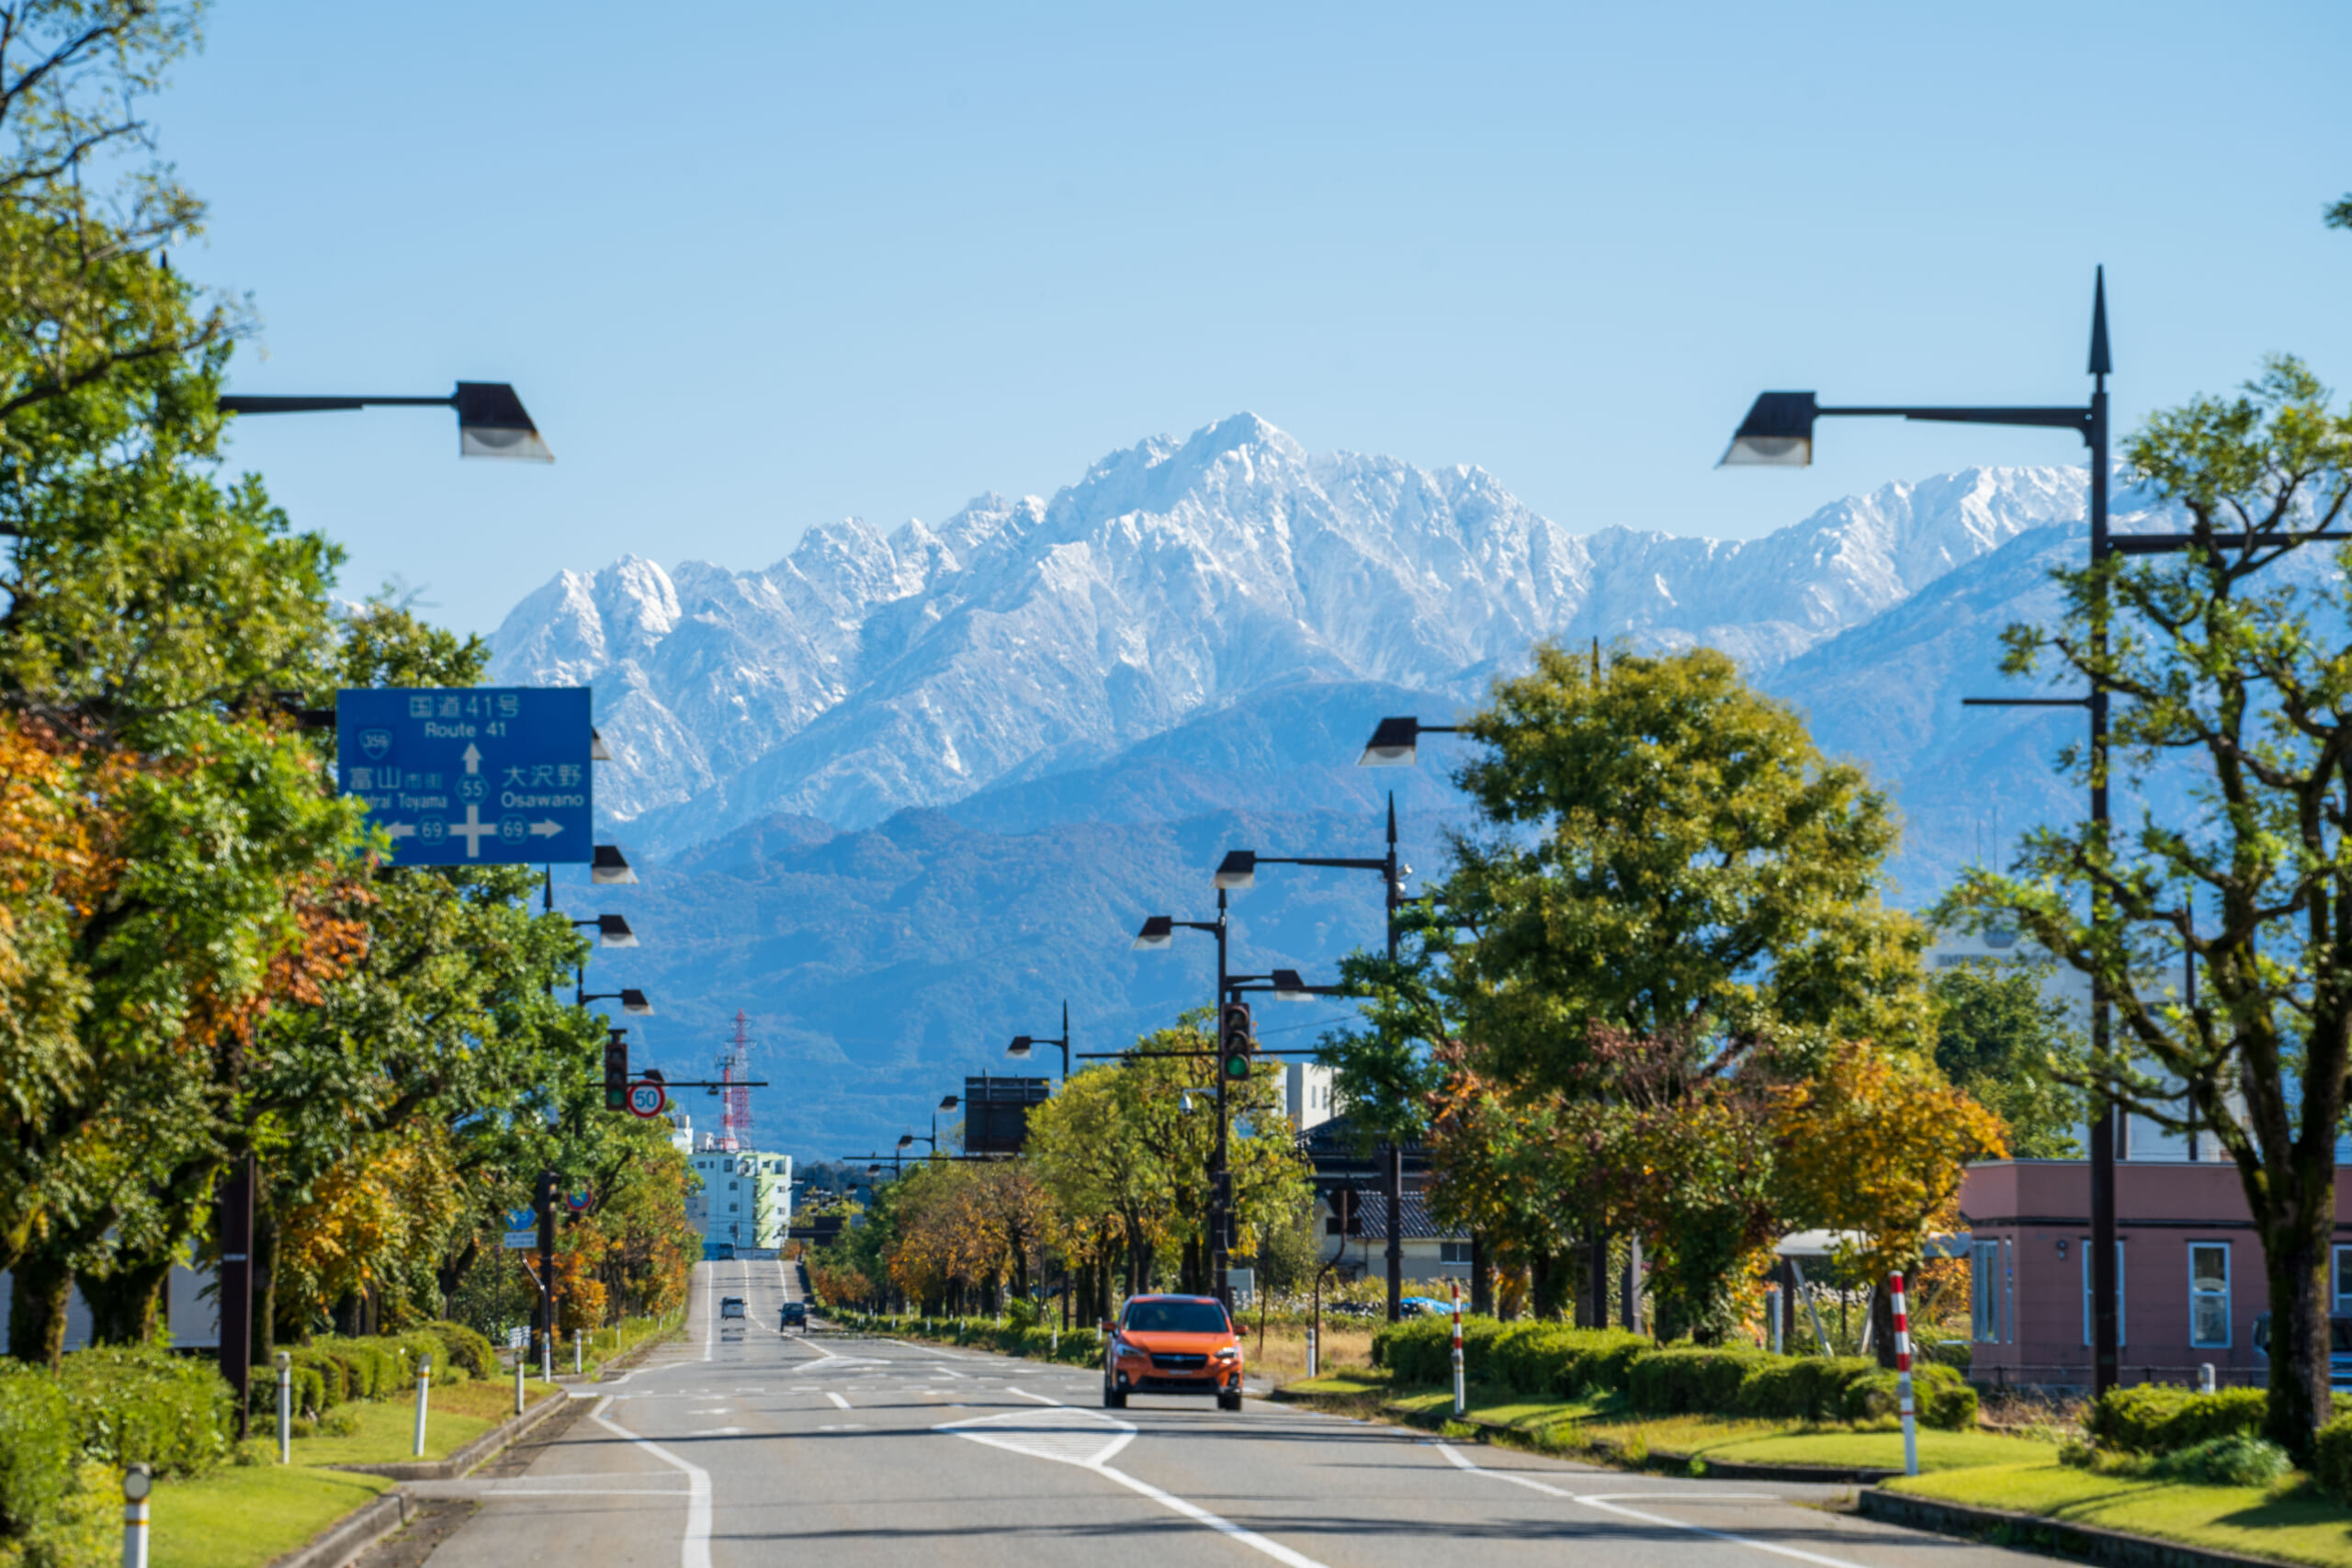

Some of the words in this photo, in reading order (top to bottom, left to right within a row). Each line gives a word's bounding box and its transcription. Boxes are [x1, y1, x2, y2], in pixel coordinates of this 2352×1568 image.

[410, 694, 520, 717] 国道41号
[424, 721, 476, 738] Route
[485, 721, 506, 738] 41
[503, 764, 582, 788] 大沢野
[462, 781, 483, 796] 55
[398, 792, 448, 812] Toyama
[501, 791, 584, 808] Osawano
[422, 822, 443, 838] 69
[503, 821, 524, 837] 69
[634, 1089, 658, 1109] 50
